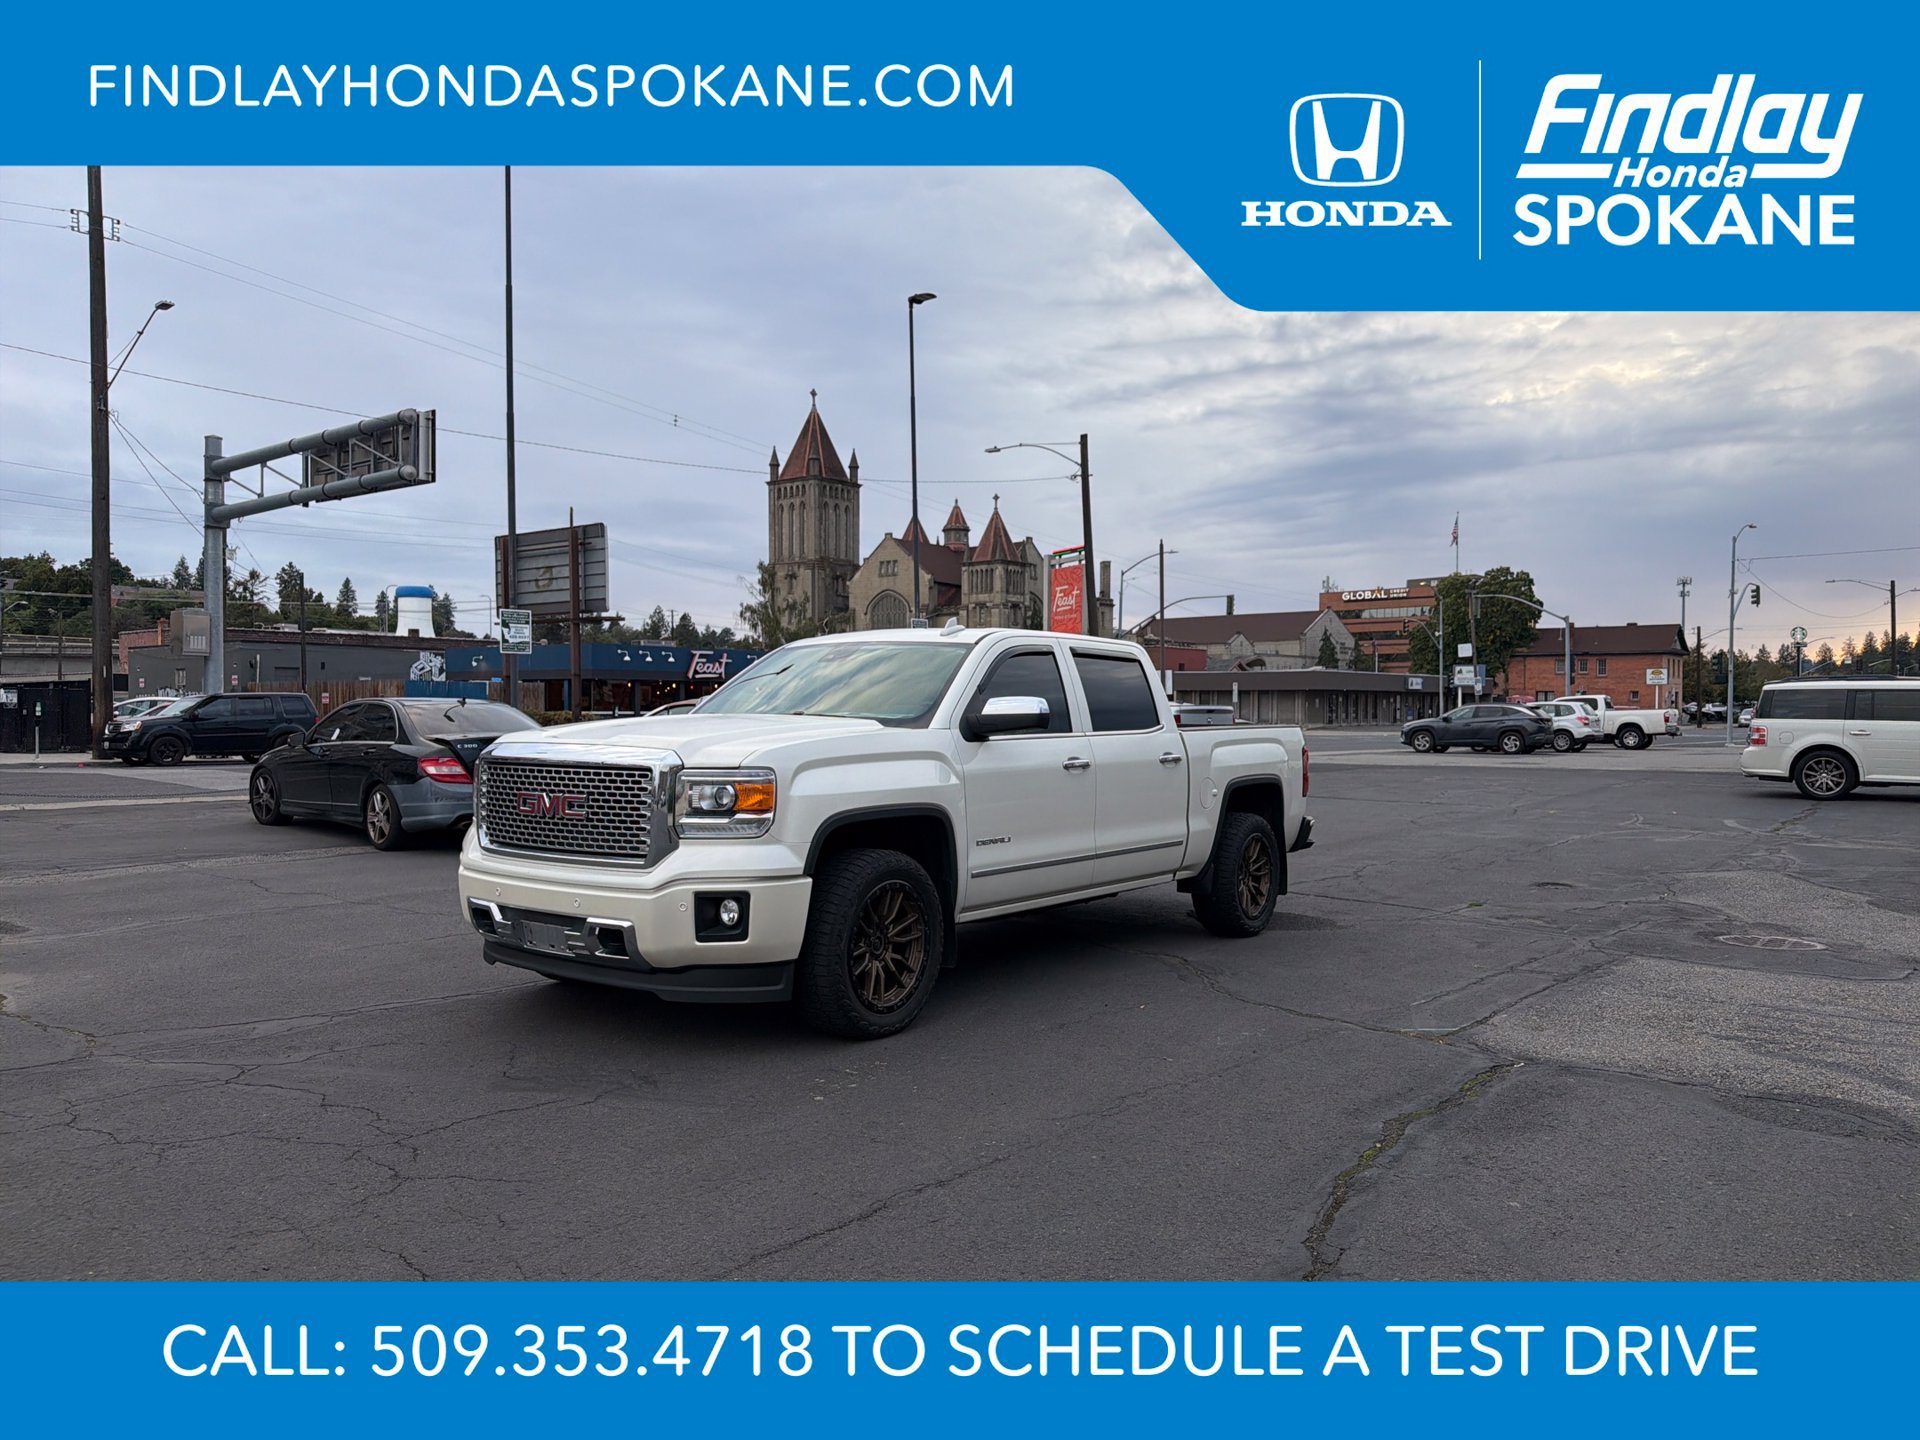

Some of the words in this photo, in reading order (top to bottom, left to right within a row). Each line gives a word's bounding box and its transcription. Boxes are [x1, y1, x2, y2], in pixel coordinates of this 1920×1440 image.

[1053, 585, 1080, 613] Feast
[1342, 589, 1388, 600] GLOBAL
[687, 650, 733, 679] Feast
[517, 791, 587, 818] GMC
[976, 836, 1011, 846] DENALI
